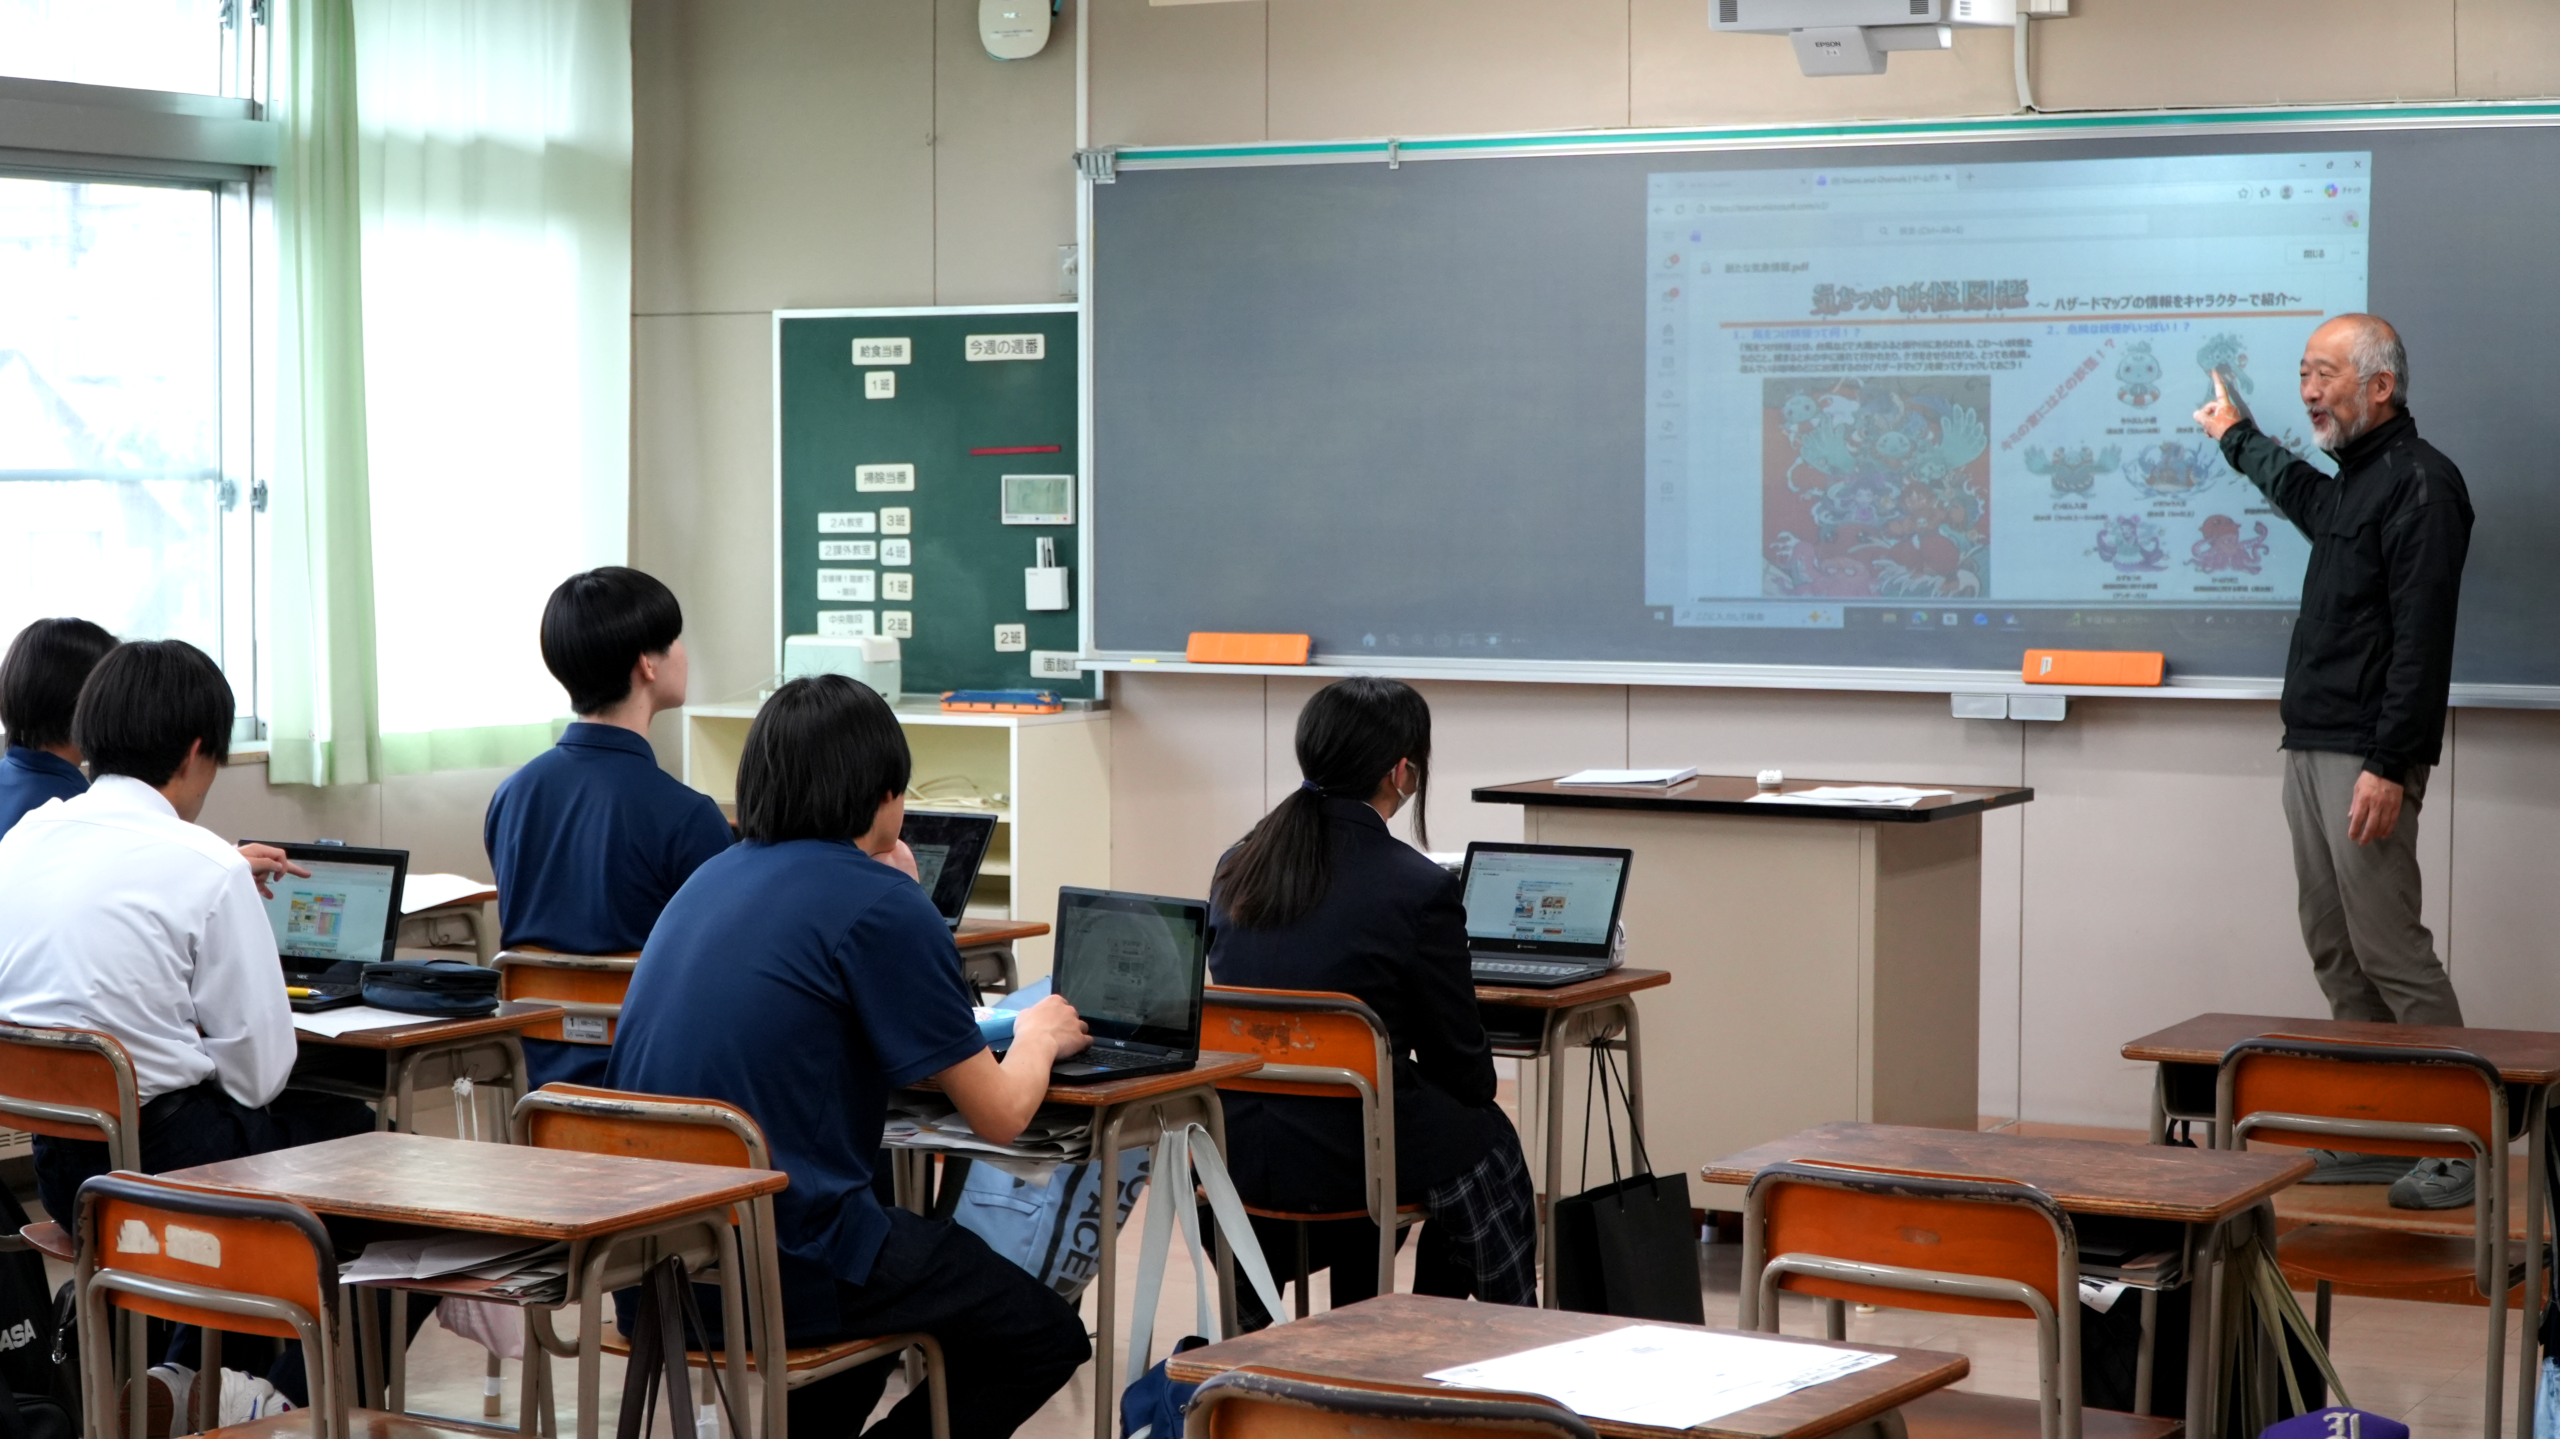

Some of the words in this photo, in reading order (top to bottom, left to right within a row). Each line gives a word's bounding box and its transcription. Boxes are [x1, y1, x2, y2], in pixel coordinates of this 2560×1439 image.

[2303, 249, 2325, 259] 閉じる
[860, 344, 903, 358] 給食当番
[970, 338, 1038, 356] 今週の週番
[872, 379, 890, 391] 1班
[864, 471, 907, 485] 掃除当番
[830, 518, 863, 528] 2A教室
[886, 514, 905, 527] 3班
[825, 545, 871, 556] 2課外教室
[885, 546, 906, 558] 4班
[889, 580, 908, 593] 1班
[829, 614, 863, 624] 中央階段
[888, 618, 908, 631] 2班
[1000, 631, 1021, 644] 2班
[570, 1018, 574, 1027] 1
